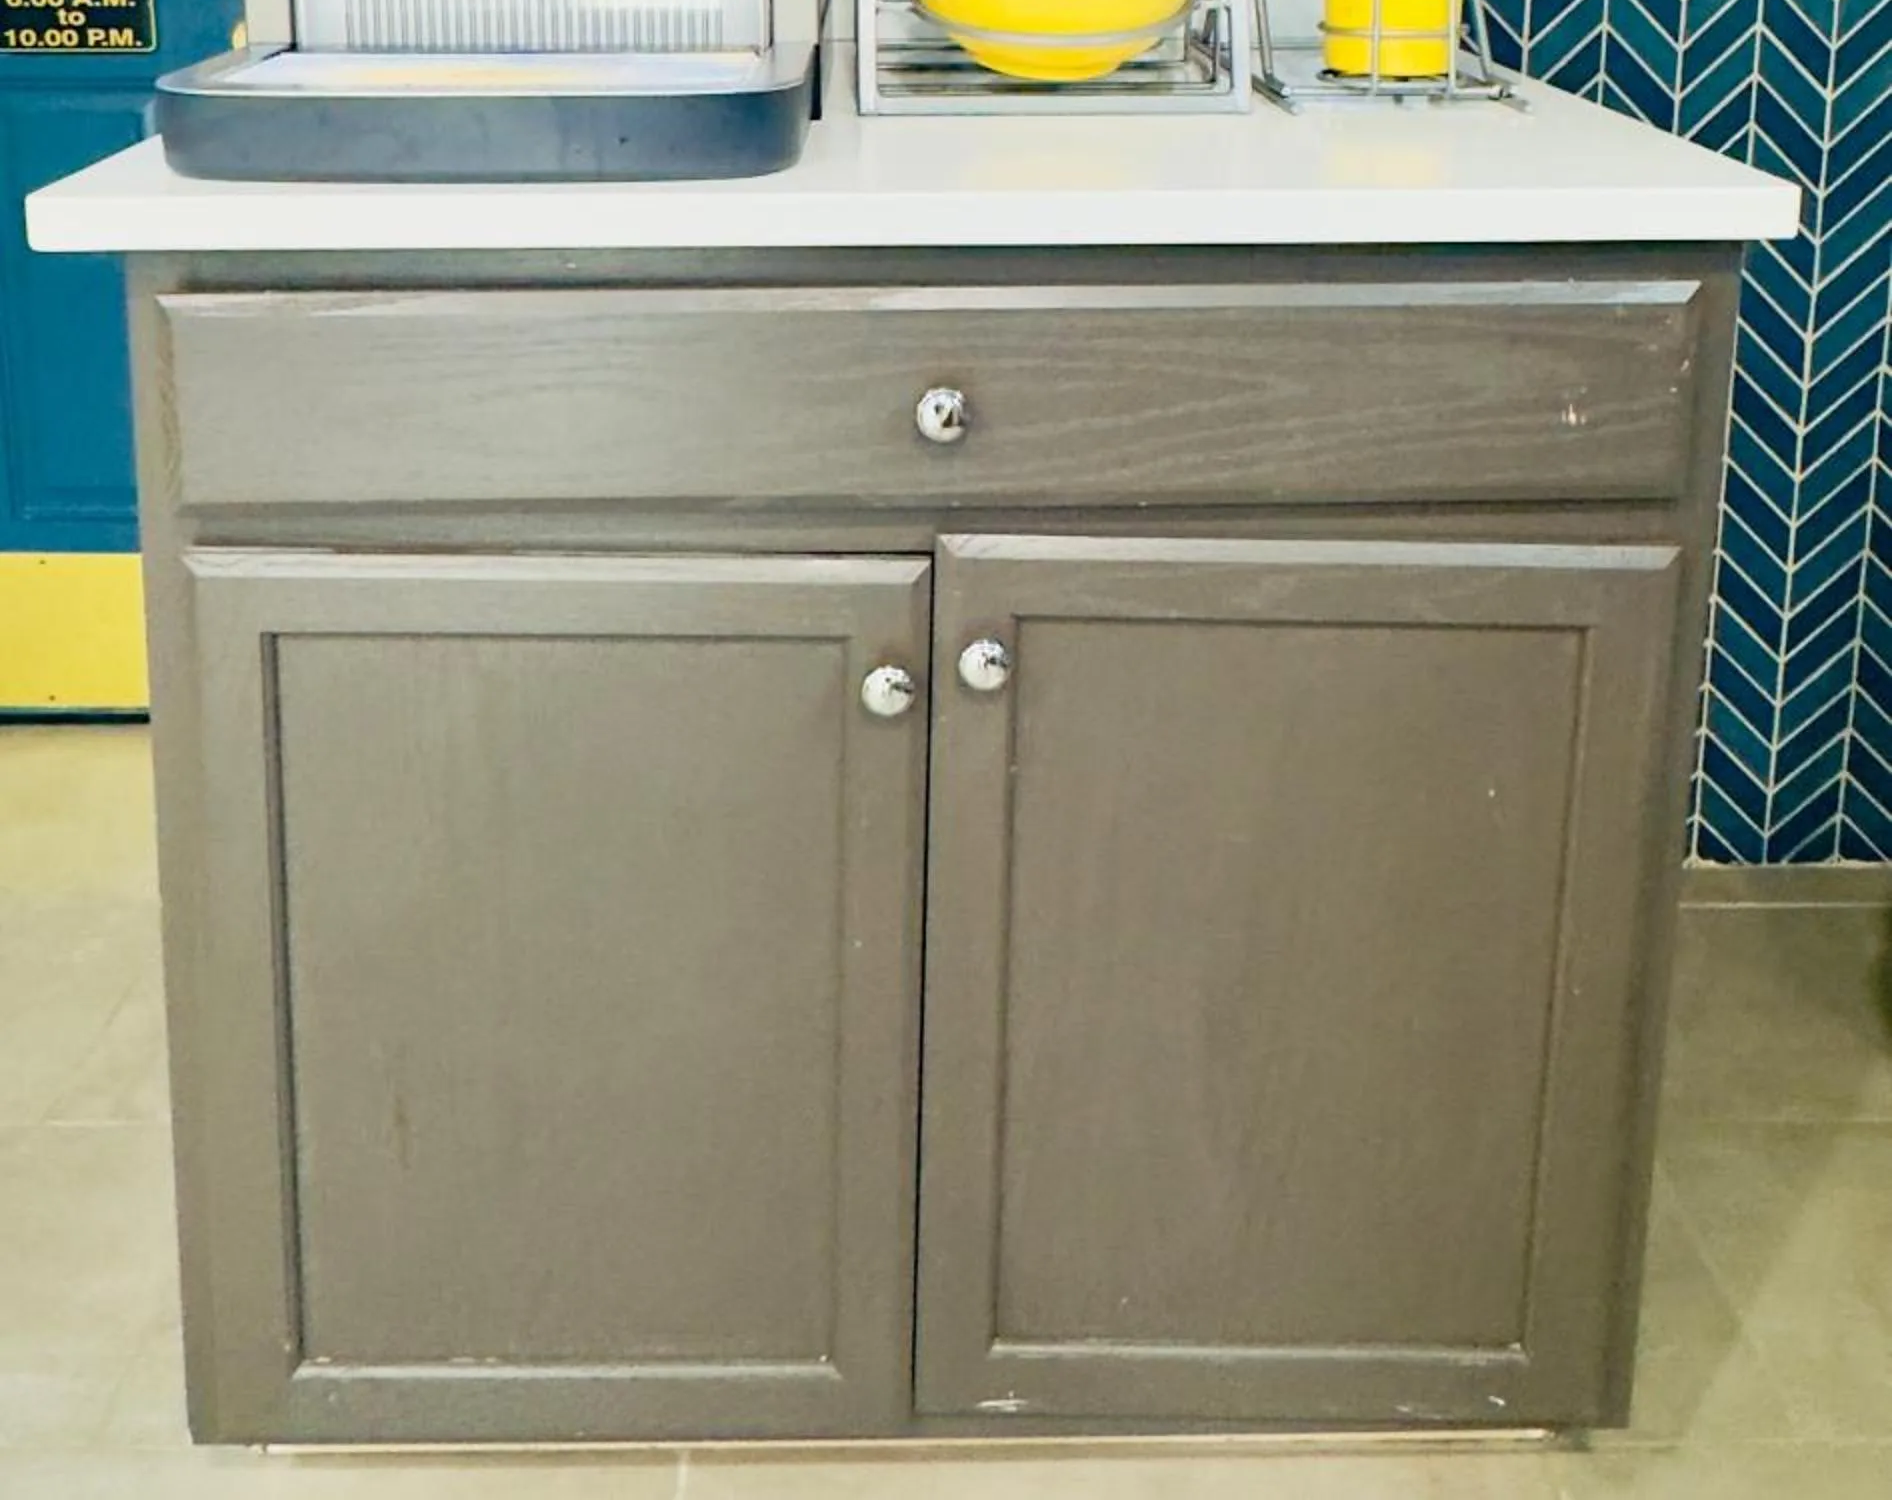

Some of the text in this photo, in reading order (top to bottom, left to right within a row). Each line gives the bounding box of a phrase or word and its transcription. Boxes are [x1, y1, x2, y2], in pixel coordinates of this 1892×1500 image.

[56, 8, 87, 26] to
[4, 28, 144, 47] 10.00 P.M.
